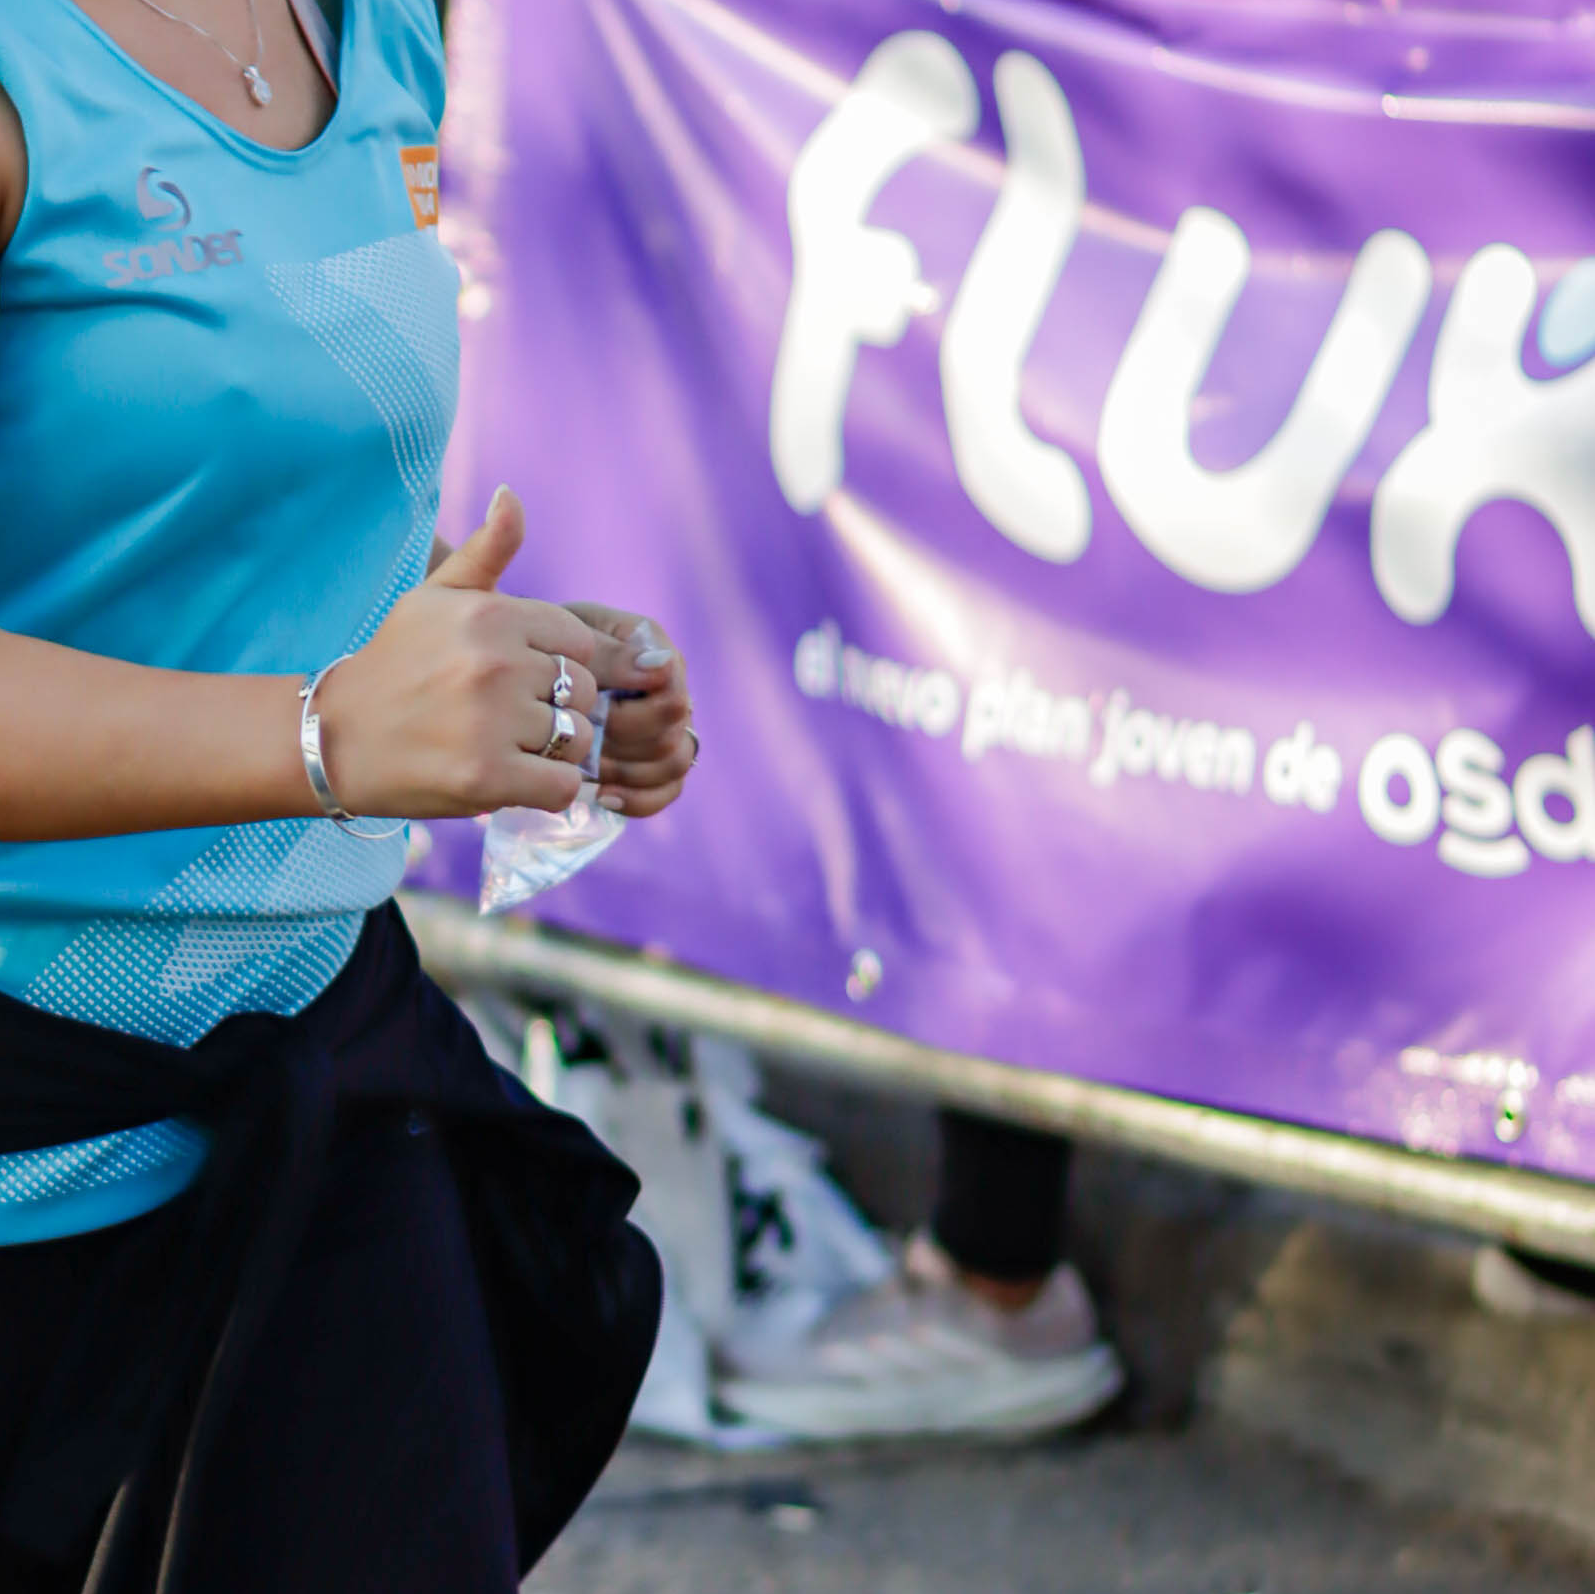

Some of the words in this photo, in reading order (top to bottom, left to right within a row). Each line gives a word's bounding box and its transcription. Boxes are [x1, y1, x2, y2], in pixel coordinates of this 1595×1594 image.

[962, 670, 1091, 764] plan
[1087, 686, 1257, 797] joven
[1263, 719, 1343, 814] de
